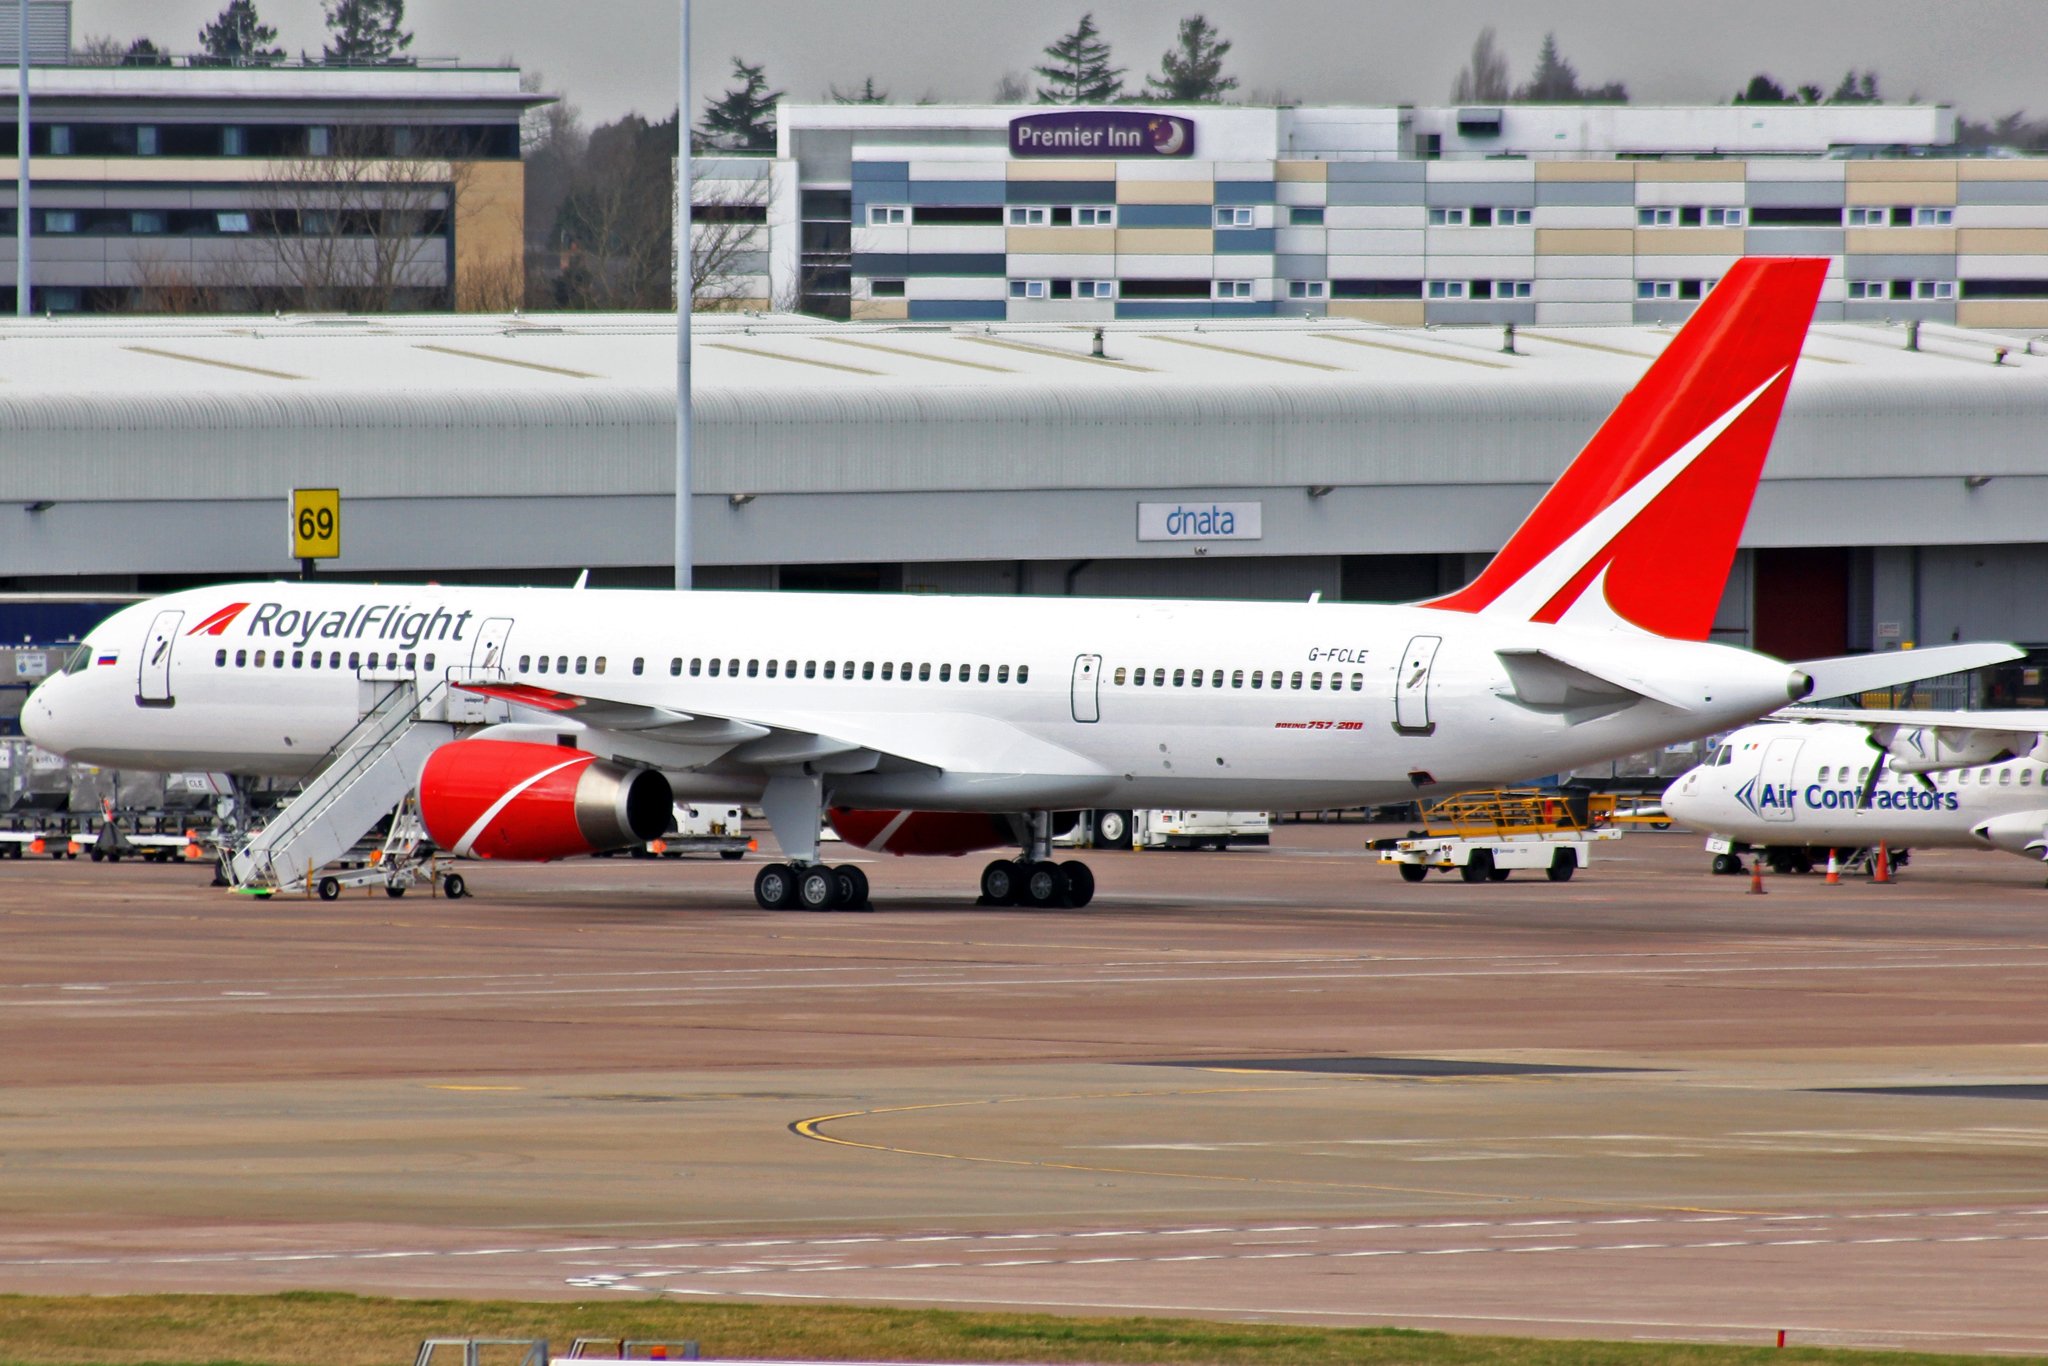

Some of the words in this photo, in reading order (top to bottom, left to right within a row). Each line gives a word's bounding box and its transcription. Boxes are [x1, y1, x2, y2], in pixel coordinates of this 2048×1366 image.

[1018, 126, 1103, 146] Premier
[1108, 127, 1141, 146] Inn
[299, 507, 333, 540] 69
[1166, 505, 1234, 535] dnata
[247, 602, 473, 650] RoyalFlight
[1308, 647, 1369, 664] G-FCLE
[1307, 721, 1363, 730] 757-200
[1760, 784, 1797, 808] Air
[1804, 785, 1959, 811] Contractors
